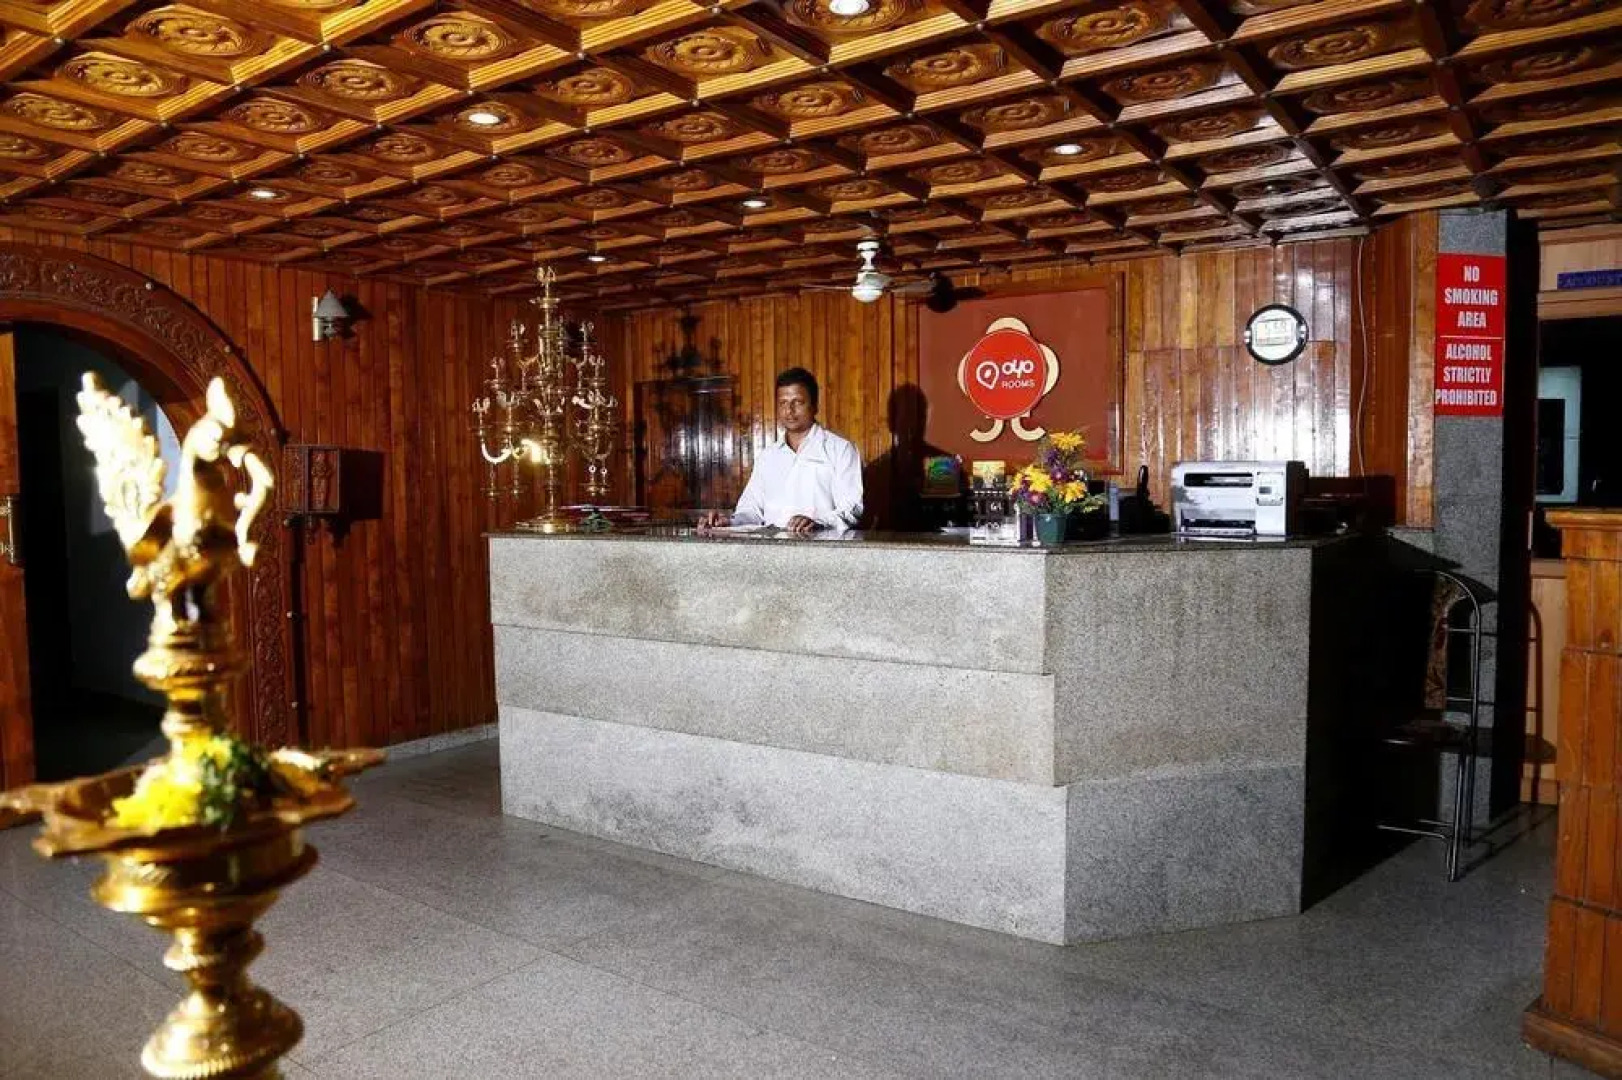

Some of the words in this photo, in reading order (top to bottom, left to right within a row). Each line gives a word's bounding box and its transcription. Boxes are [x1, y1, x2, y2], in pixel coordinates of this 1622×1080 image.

[1463, 265, 1480, 282] NO
[1444, 287, 1498, 305] SMOKING
[1457, 311, 1487, 328] AREA
[1445, 344, 1492, 361] ALCOHOL
[1443, 366, 1492, 384] STRICTLY
[1002, 380, 1036, 389] ROOMS
[1435, 388, 1497, 406] PROHIBITED
